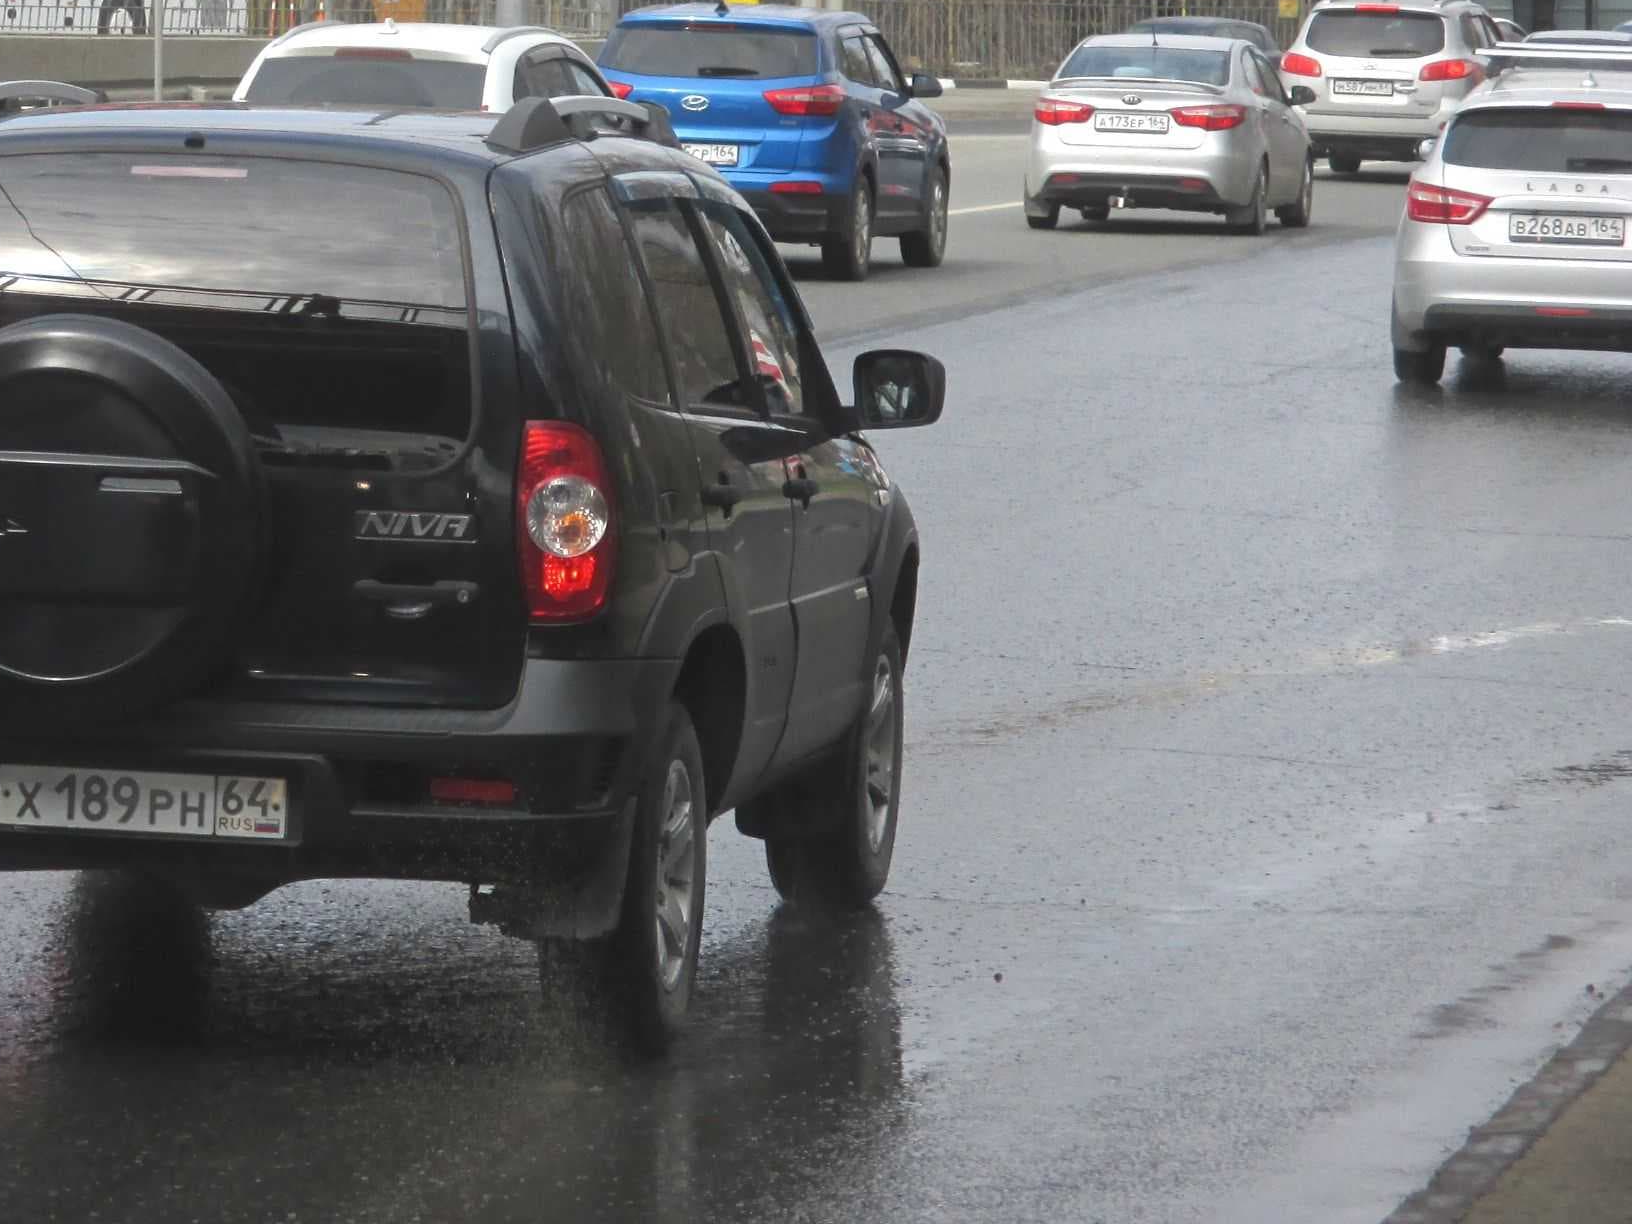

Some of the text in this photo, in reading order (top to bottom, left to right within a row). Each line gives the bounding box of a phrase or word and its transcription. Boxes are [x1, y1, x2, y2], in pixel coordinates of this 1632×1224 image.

[1526, 182, 1609, 194] LADA
[1515, 216, 1587, 237] В268АВ
[358, 511, 471, 539] NIVA
[15, 772, 270, 828] Х189РН 64
[218, 816, 253, 831] RUS
